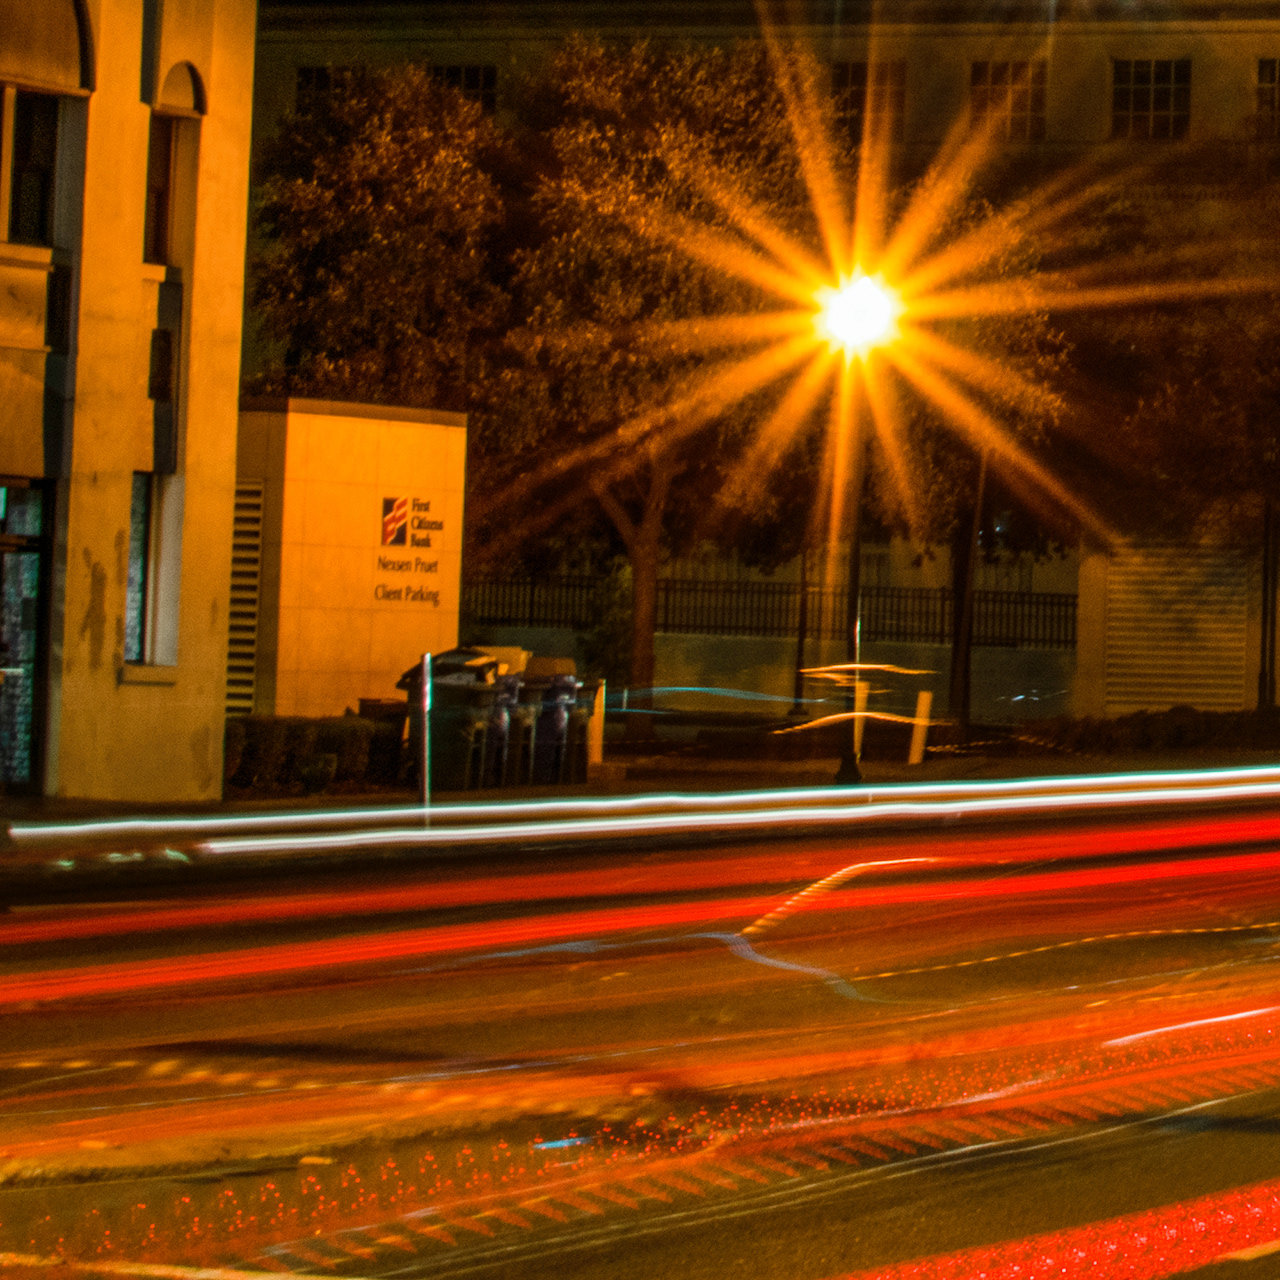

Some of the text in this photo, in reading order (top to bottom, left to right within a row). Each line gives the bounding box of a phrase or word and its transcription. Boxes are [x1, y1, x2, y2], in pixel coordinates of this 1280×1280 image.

[412, 498, 430, 512] First
[411, 515, 443, 531] Citizens
[411, 533, 431, 547] Bank
[374, 584, 439, 608] Client Parking
